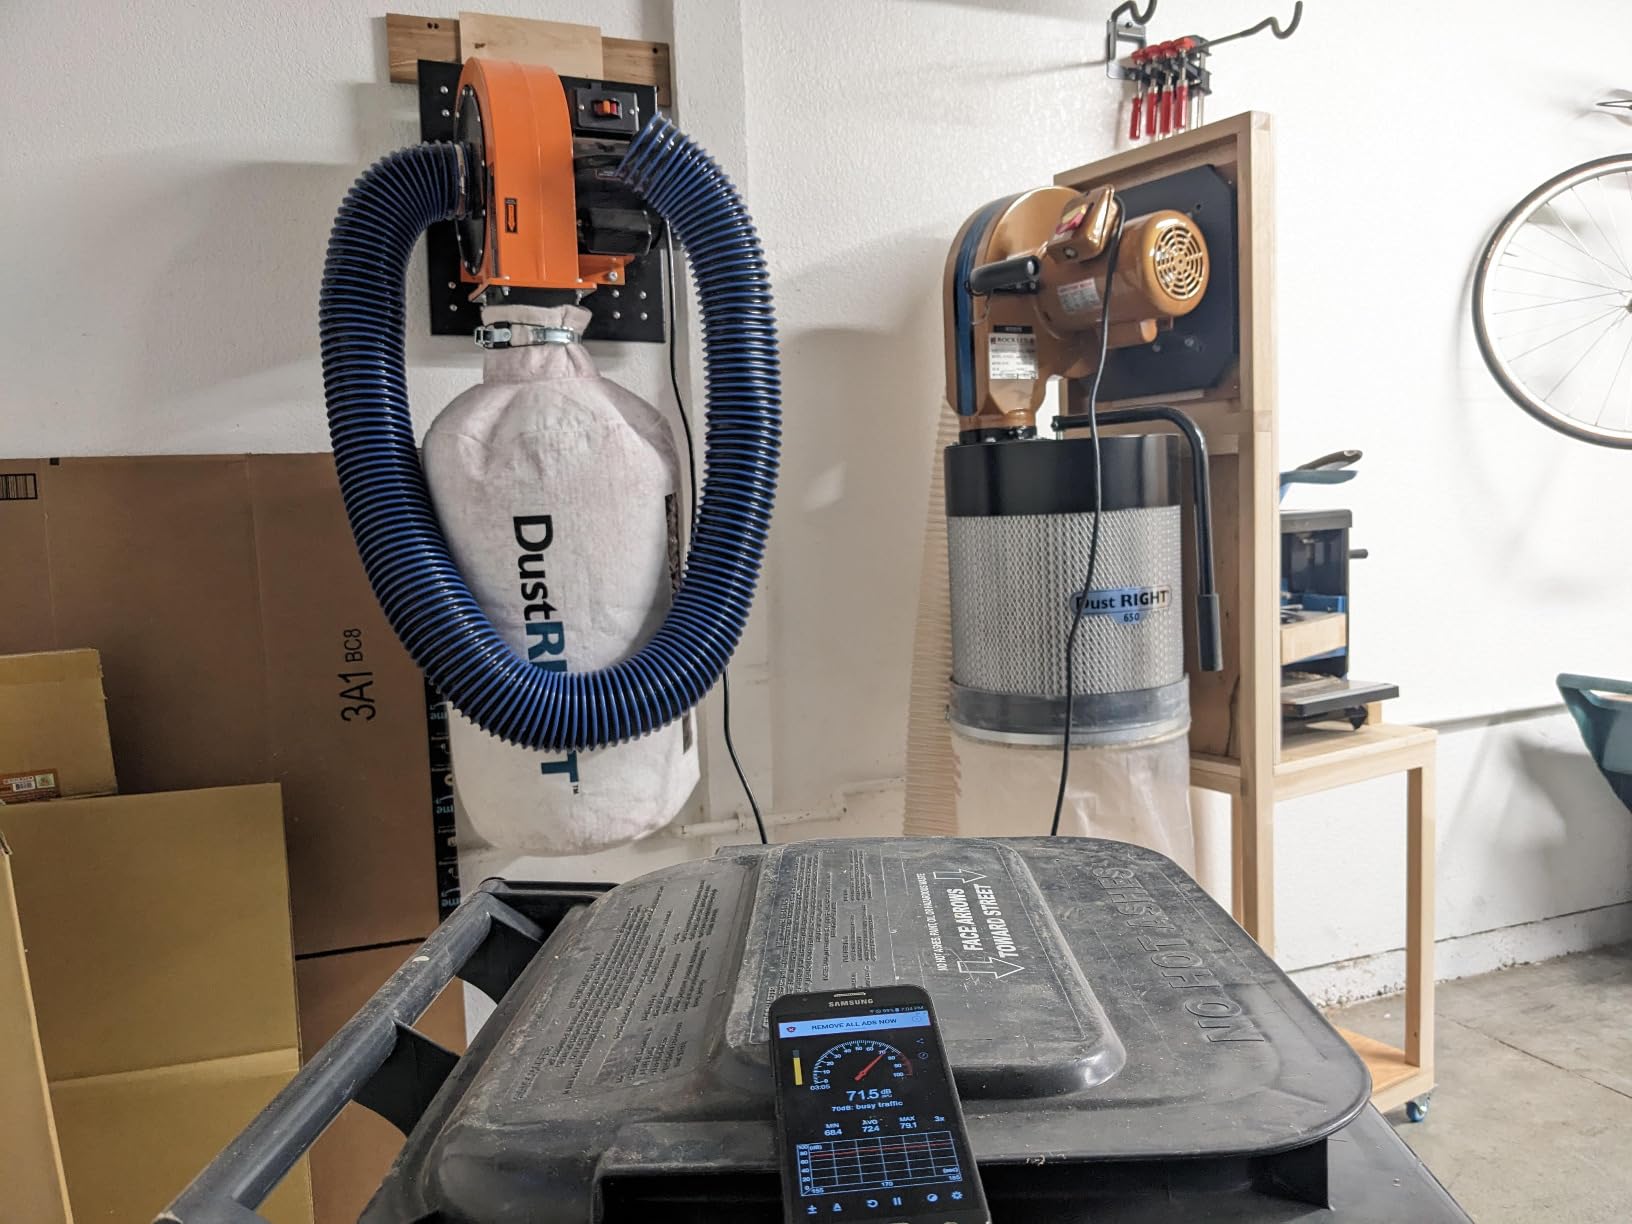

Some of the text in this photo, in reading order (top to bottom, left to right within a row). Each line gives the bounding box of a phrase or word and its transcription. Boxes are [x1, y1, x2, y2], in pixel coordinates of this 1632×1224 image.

[1120, 590, 1169, 608] RIGHT
[1123, 612, 1140, 622] 650
[338, 628, 376, 721] 3A1 BC8
[946, 888, 984, 951] FACE ARROWS
[973, 883, 1019, 958] TOWARD STREET
[828, 998, 874, 1008] SAMSUNG
[811, 1023, 844, 1032] REMOVE
[845, 1021, 860, 1029] ALL
[846, 1089, 880, 1101] 71.5
[878, 1100, 903, 1108] traffic
